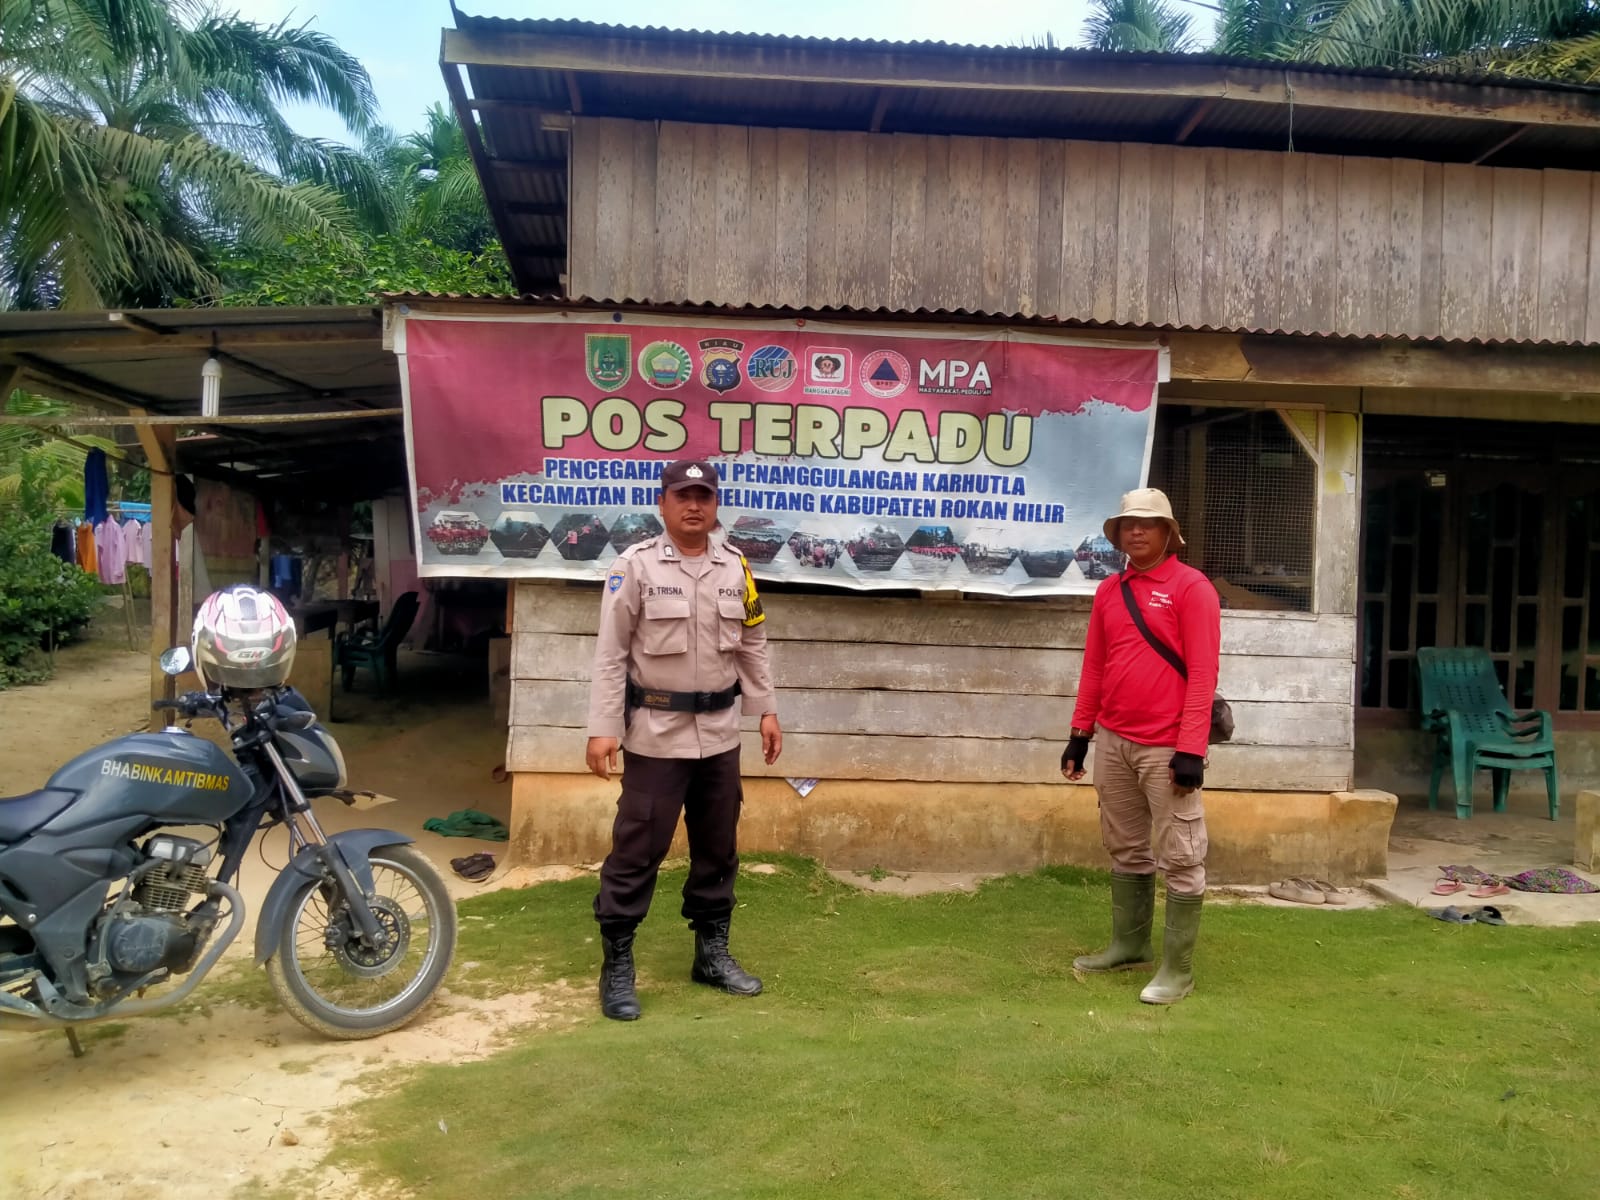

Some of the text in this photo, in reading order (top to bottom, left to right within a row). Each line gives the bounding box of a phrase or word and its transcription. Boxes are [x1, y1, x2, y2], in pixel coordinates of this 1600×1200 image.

[754, 358, 794, 378] RUJ
[918, 358, 992, 388] MPA
[541, 396, 1033, 467] POS TERPADU
[545, 459, 672, 480] PENCEGAHA
[733, 463, 917, 491] PENANGGULANGAN
[923, 473, 1025, 496] KARHUTLA
[502, 484, 625, 506] KECAMATAN
[718, 488, 814, 512] ELINTANG
[820, 495, 936, 518] KABUPATEN
[940, 500, 1006, 520] ROKAN
[1013, 503, 1065, 523] HILIR
[656, 586, 683, 596] TRISNA
[100, 759, 230, 791] BHABINKAMTIBMAS
